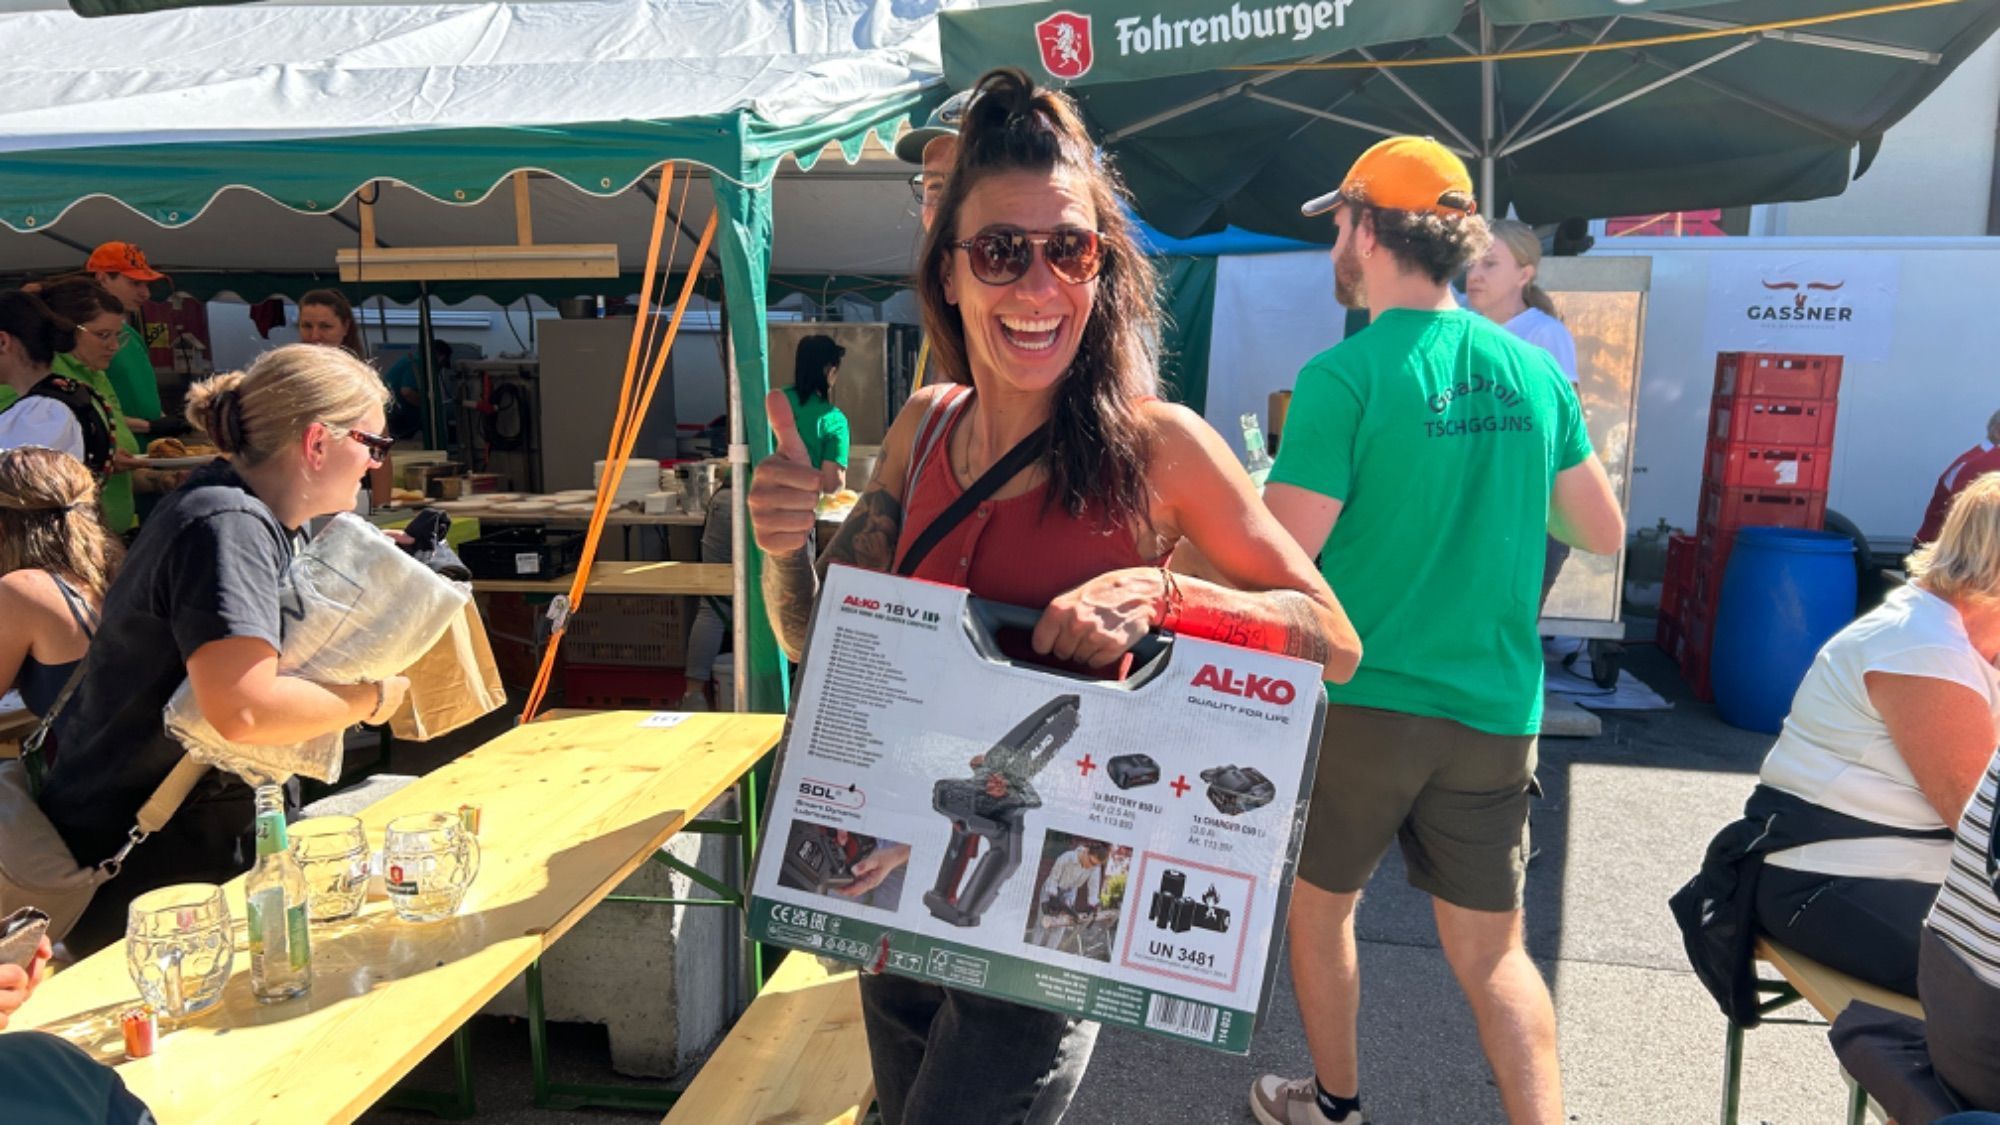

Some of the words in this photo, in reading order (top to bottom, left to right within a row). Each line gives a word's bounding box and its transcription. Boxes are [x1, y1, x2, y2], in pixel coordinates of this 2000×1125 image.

[1114, 0, 1352, 56] Fohrenburger
[1747, 305, 1852, 321] GASSNER
[1190, 664, 1296, 705] AL-KO
[1188, 696, 1237, 711] QUALITY
[1239, 708, 1262, 718] FOR
[1265, 712, 1289, 724] LIFE
[1149, 940, 1173, 958] UN
[1178, 947, 1215, 967] 3481
